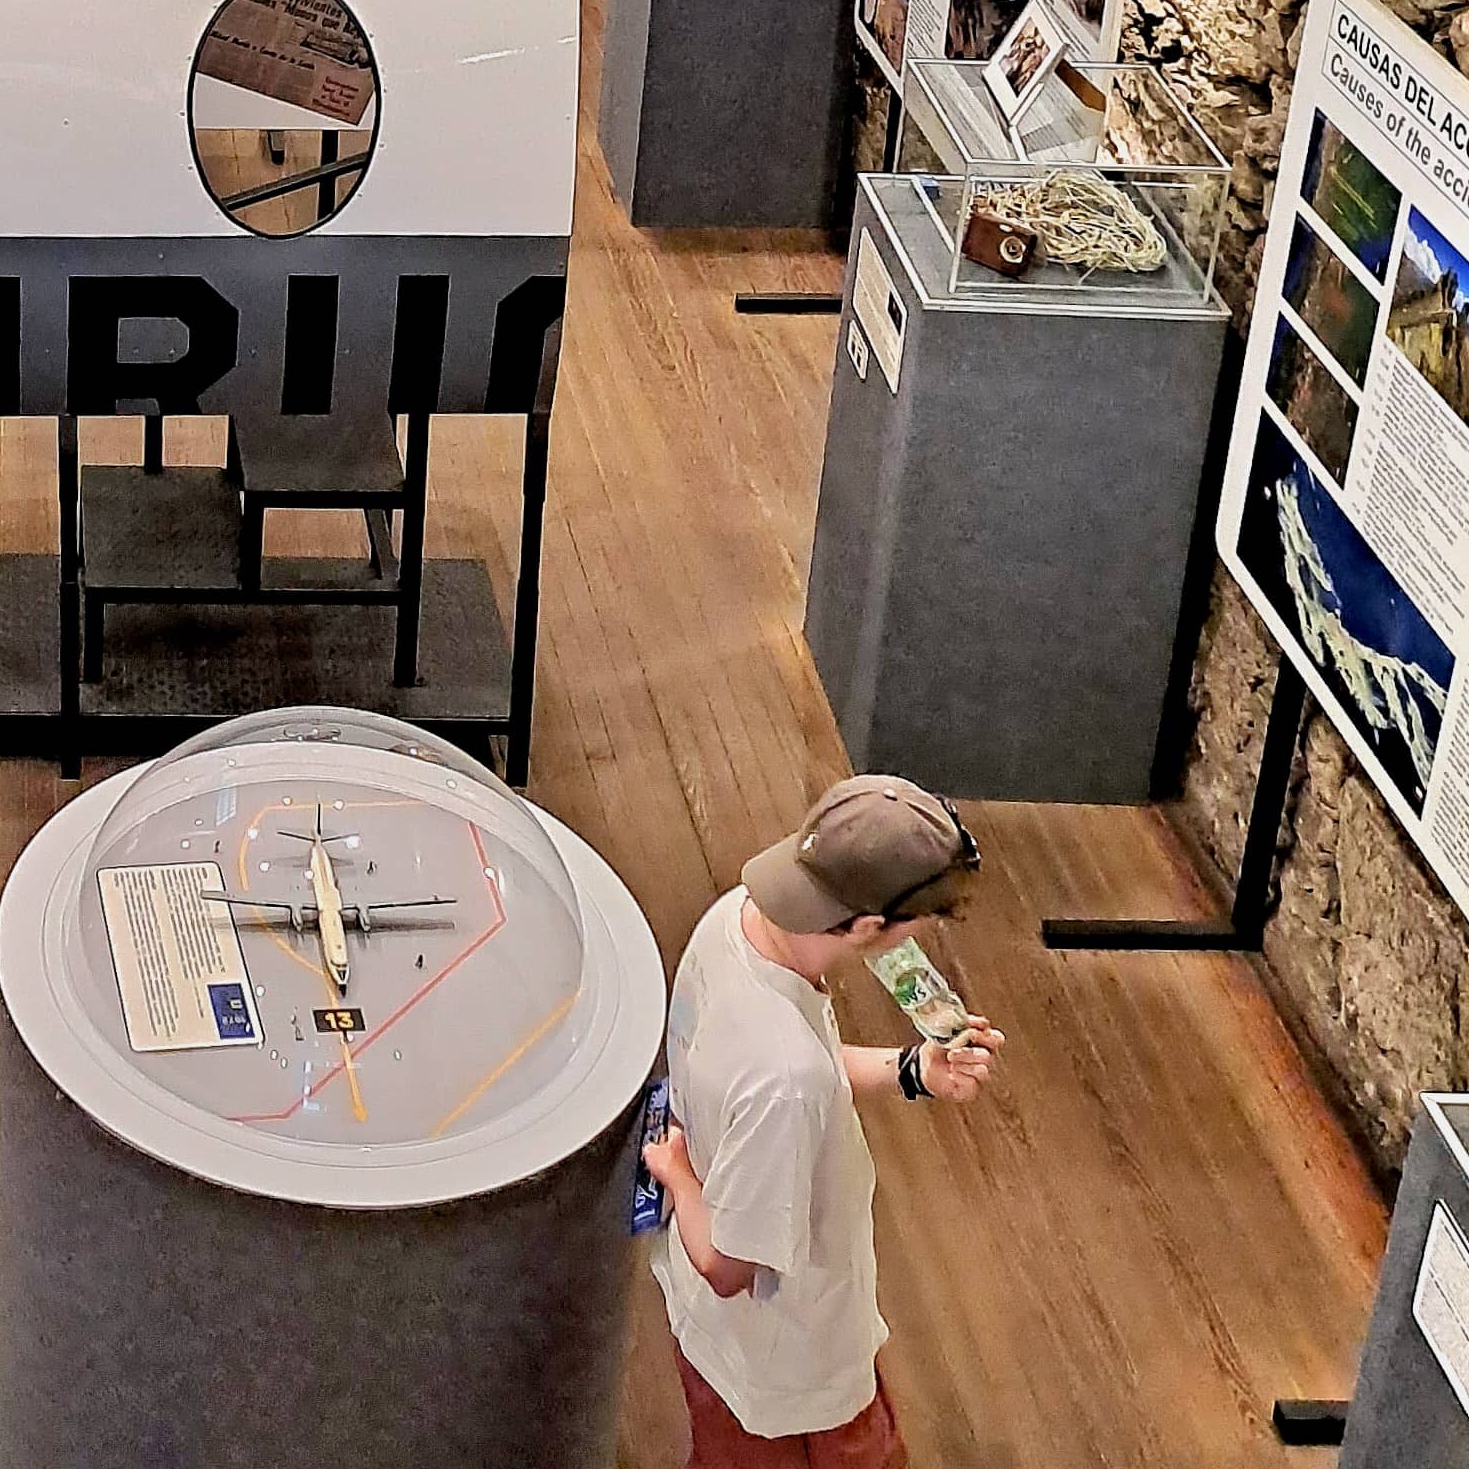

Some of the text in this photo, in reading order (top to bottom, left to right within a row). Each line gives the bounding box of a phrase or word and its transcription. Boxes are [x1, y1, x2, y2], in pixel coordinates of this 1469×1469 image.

[1331, 53, 1383, 119] Causes
[1386, 111, 1405, 137] of
[1405, 125, 1431, 166] the
[1337, 13, 1469, 156] CAUSAS DEL AC
[325, 1012, 354, 1029] 13
